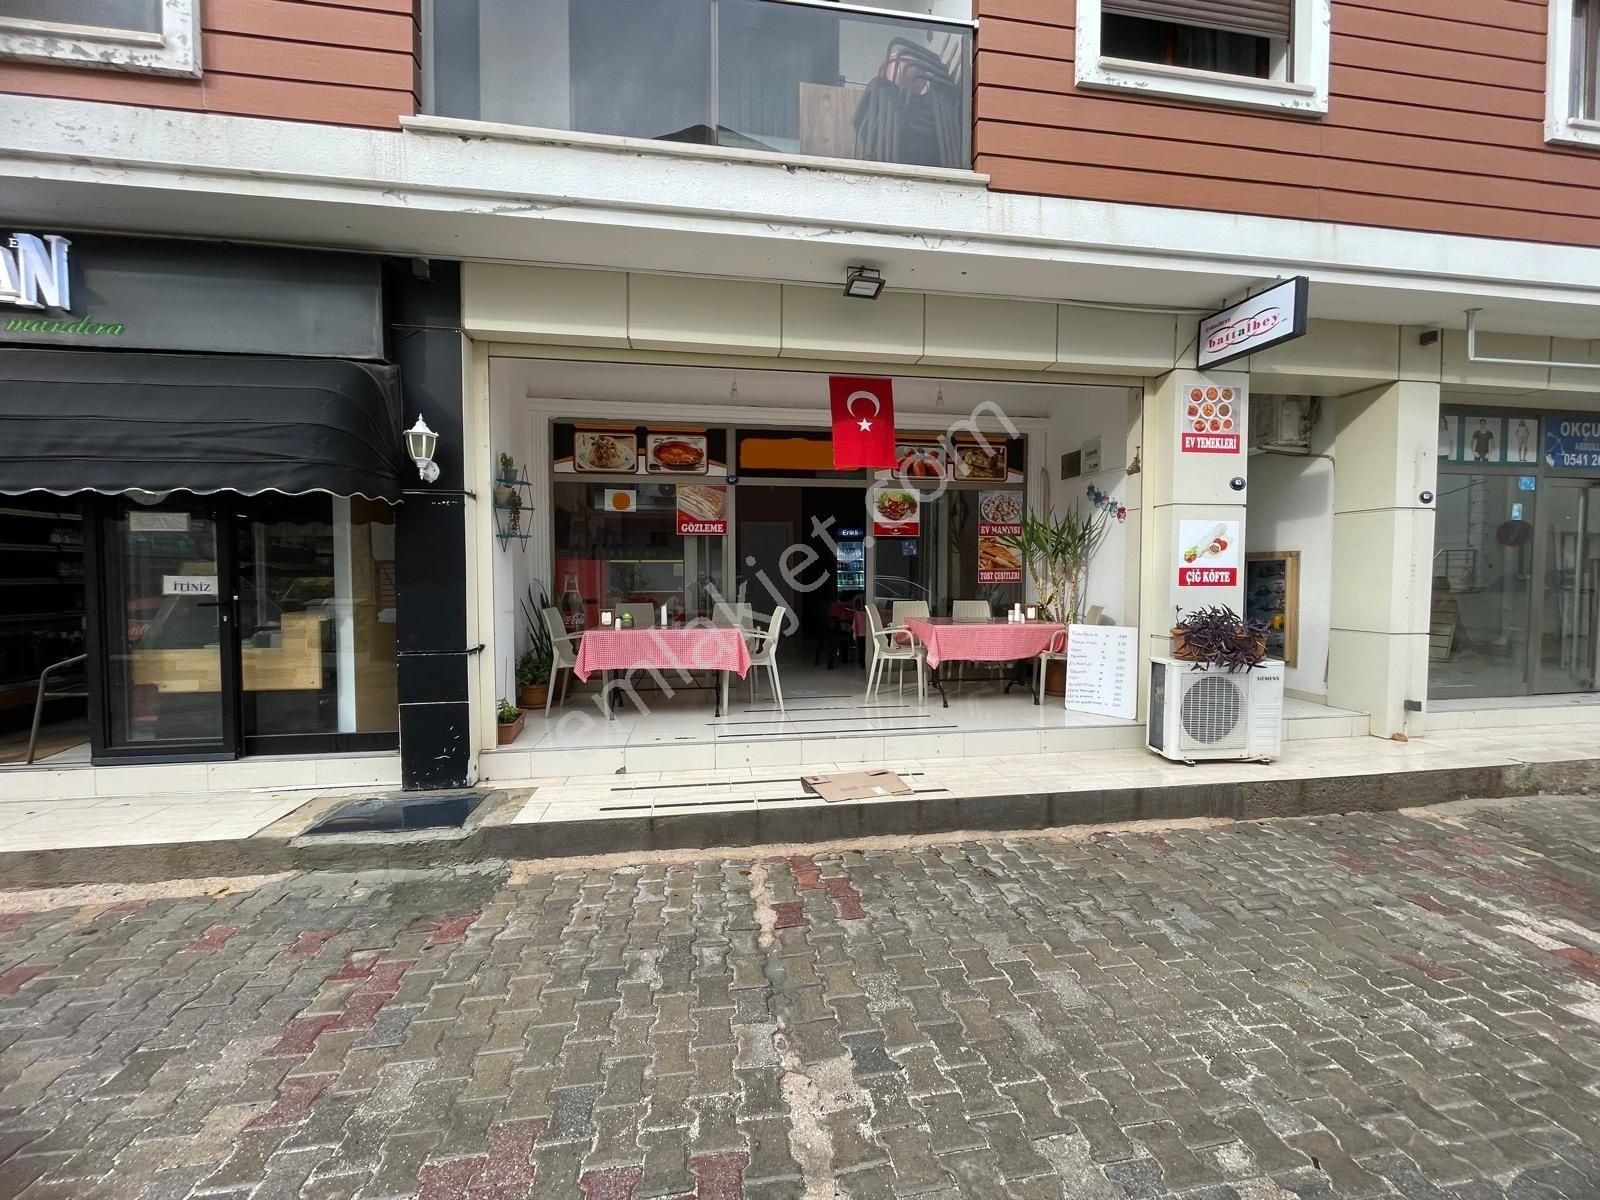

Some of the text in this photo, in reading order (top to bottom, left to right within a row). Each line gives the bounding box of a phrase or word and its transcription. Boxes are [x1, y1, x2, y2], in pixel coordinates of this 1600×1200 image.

[1185, 436, 1237, 449] EV YEMEKLERİ
[1563, 453, 1589, 466] 0541
[681, 522, 724, 533] GÖZLEME
[980, 525, 990, 535] EV
[980, 571, 994, 580] TOST
[1186, 569, 1231, 585] ÇİĞ KÖFTE
